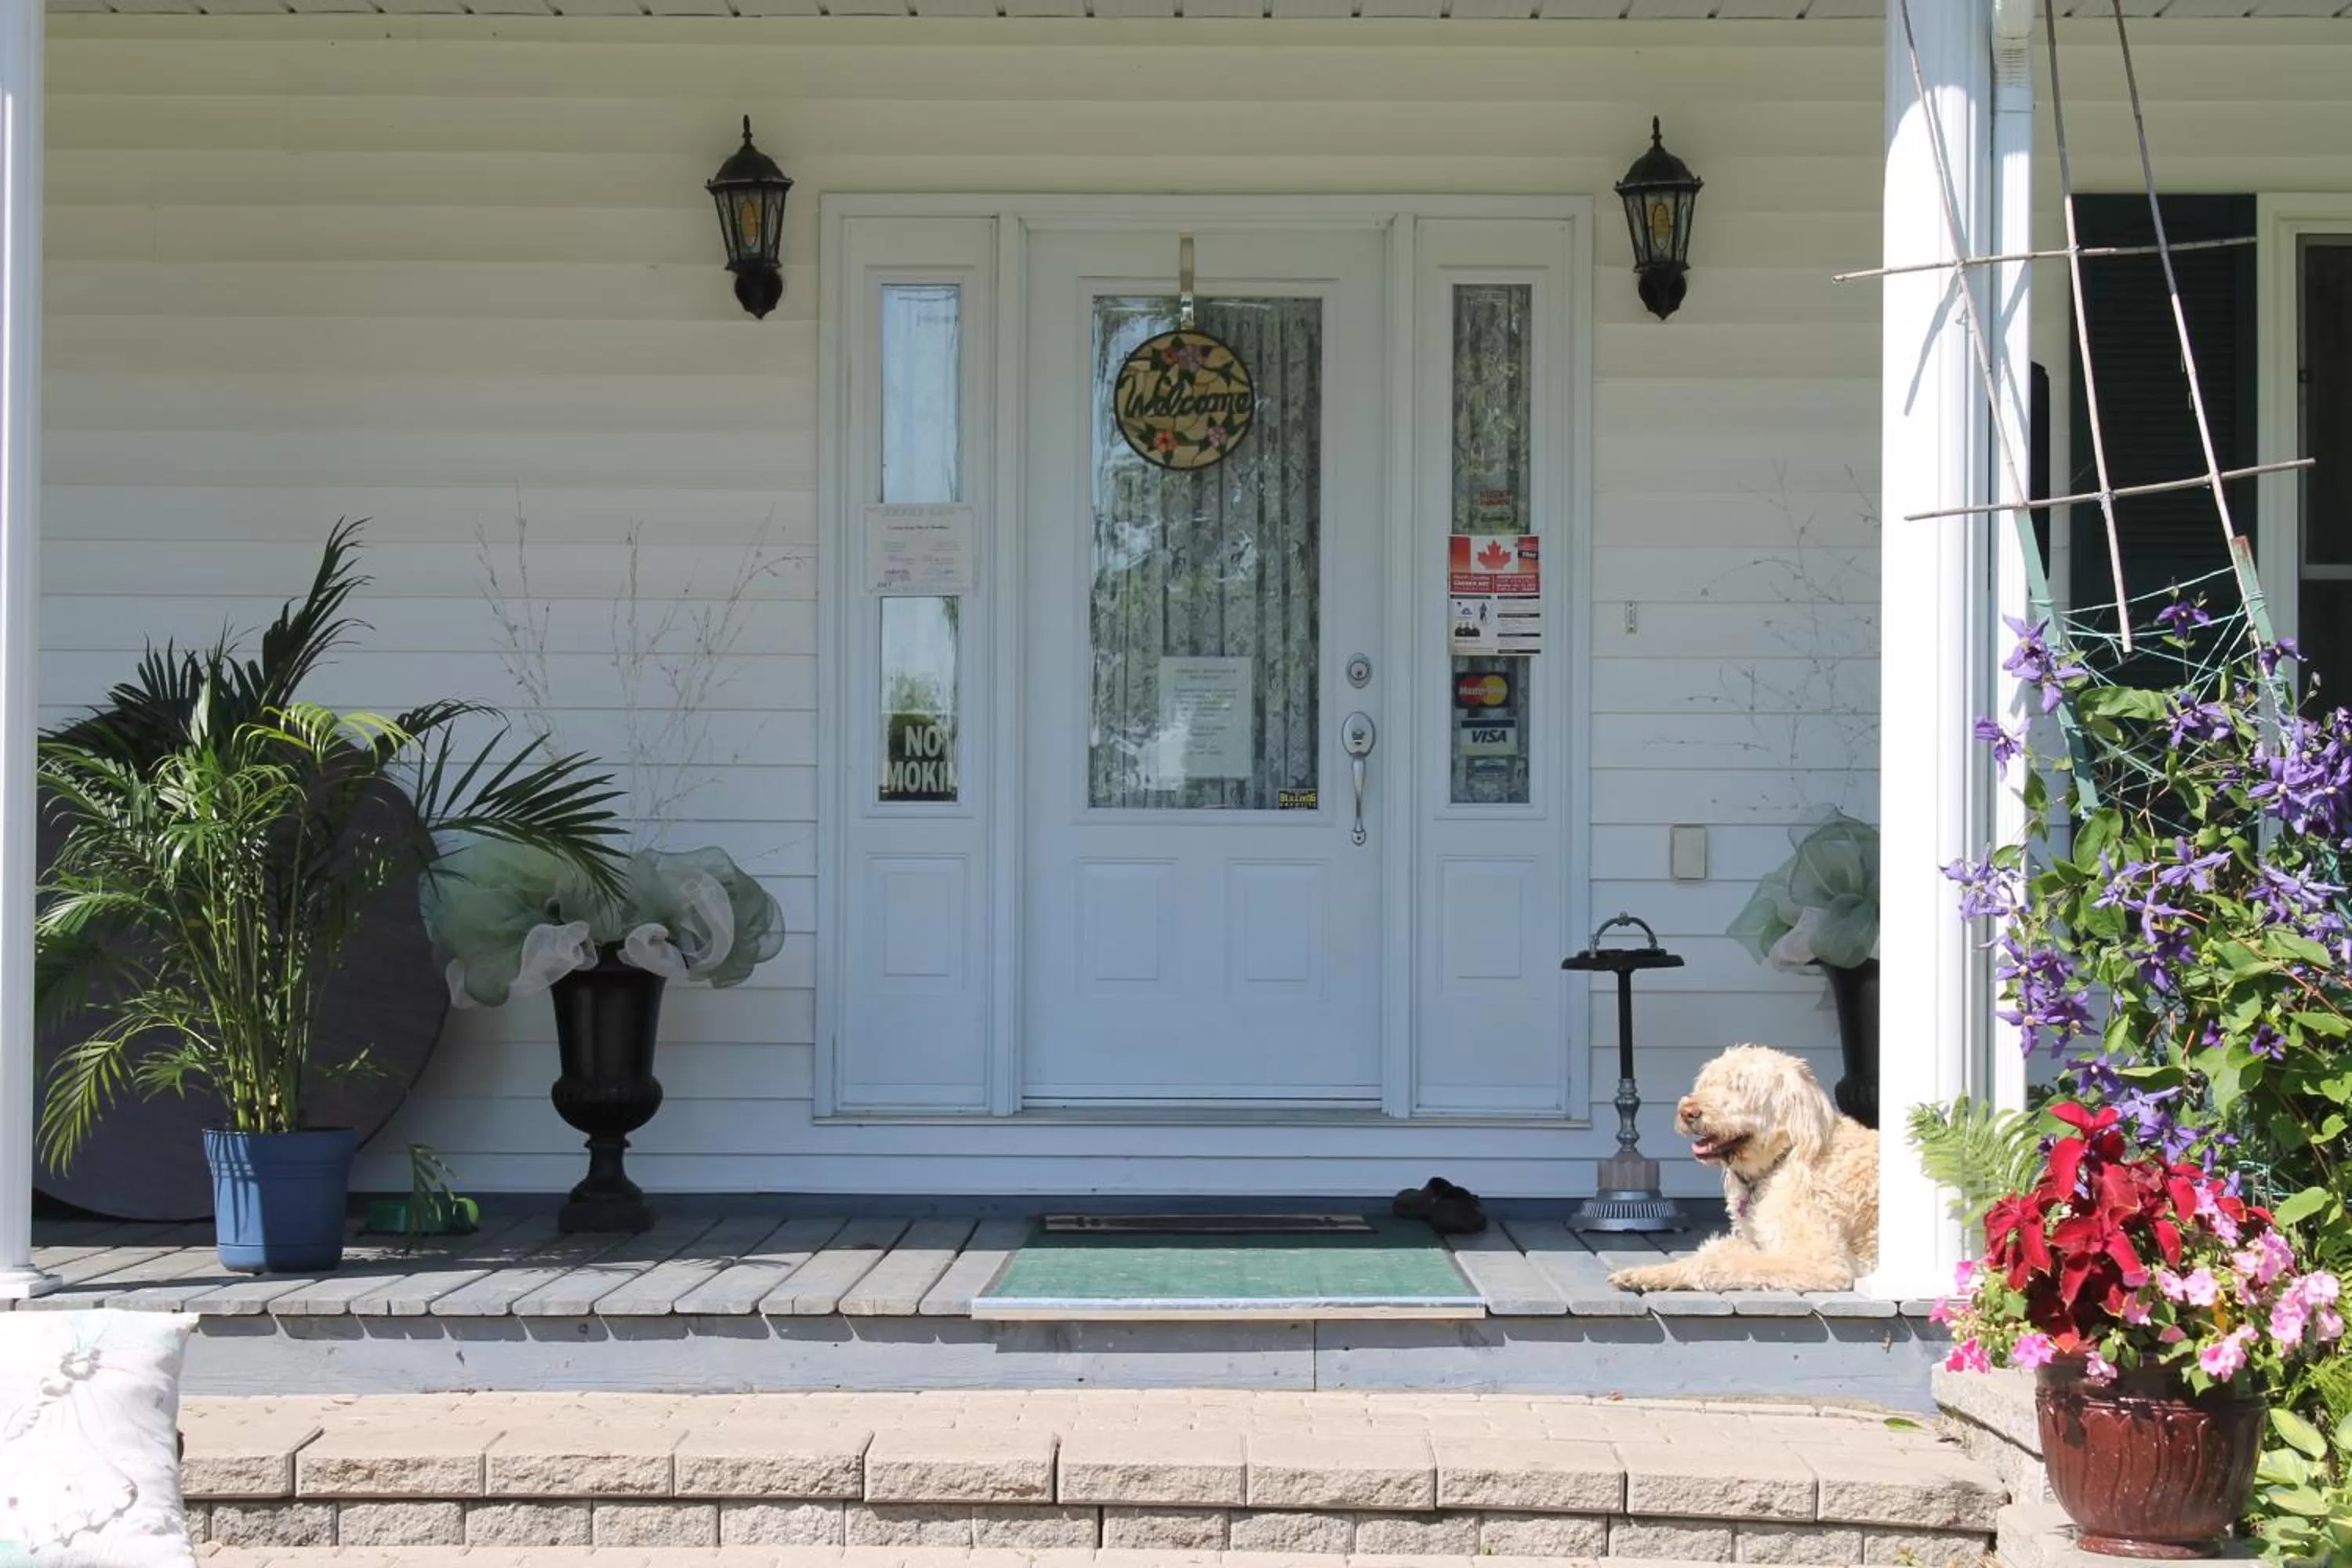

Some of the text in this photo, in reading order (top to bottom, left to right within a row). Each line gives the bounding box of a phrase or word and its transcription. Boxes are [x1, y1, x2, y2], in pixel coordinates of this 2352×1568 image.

[1119, 374, 1250, 418] Welcome
[905, 725, 942, 758] NO
[1472, 729, 1508, 743] VISA
